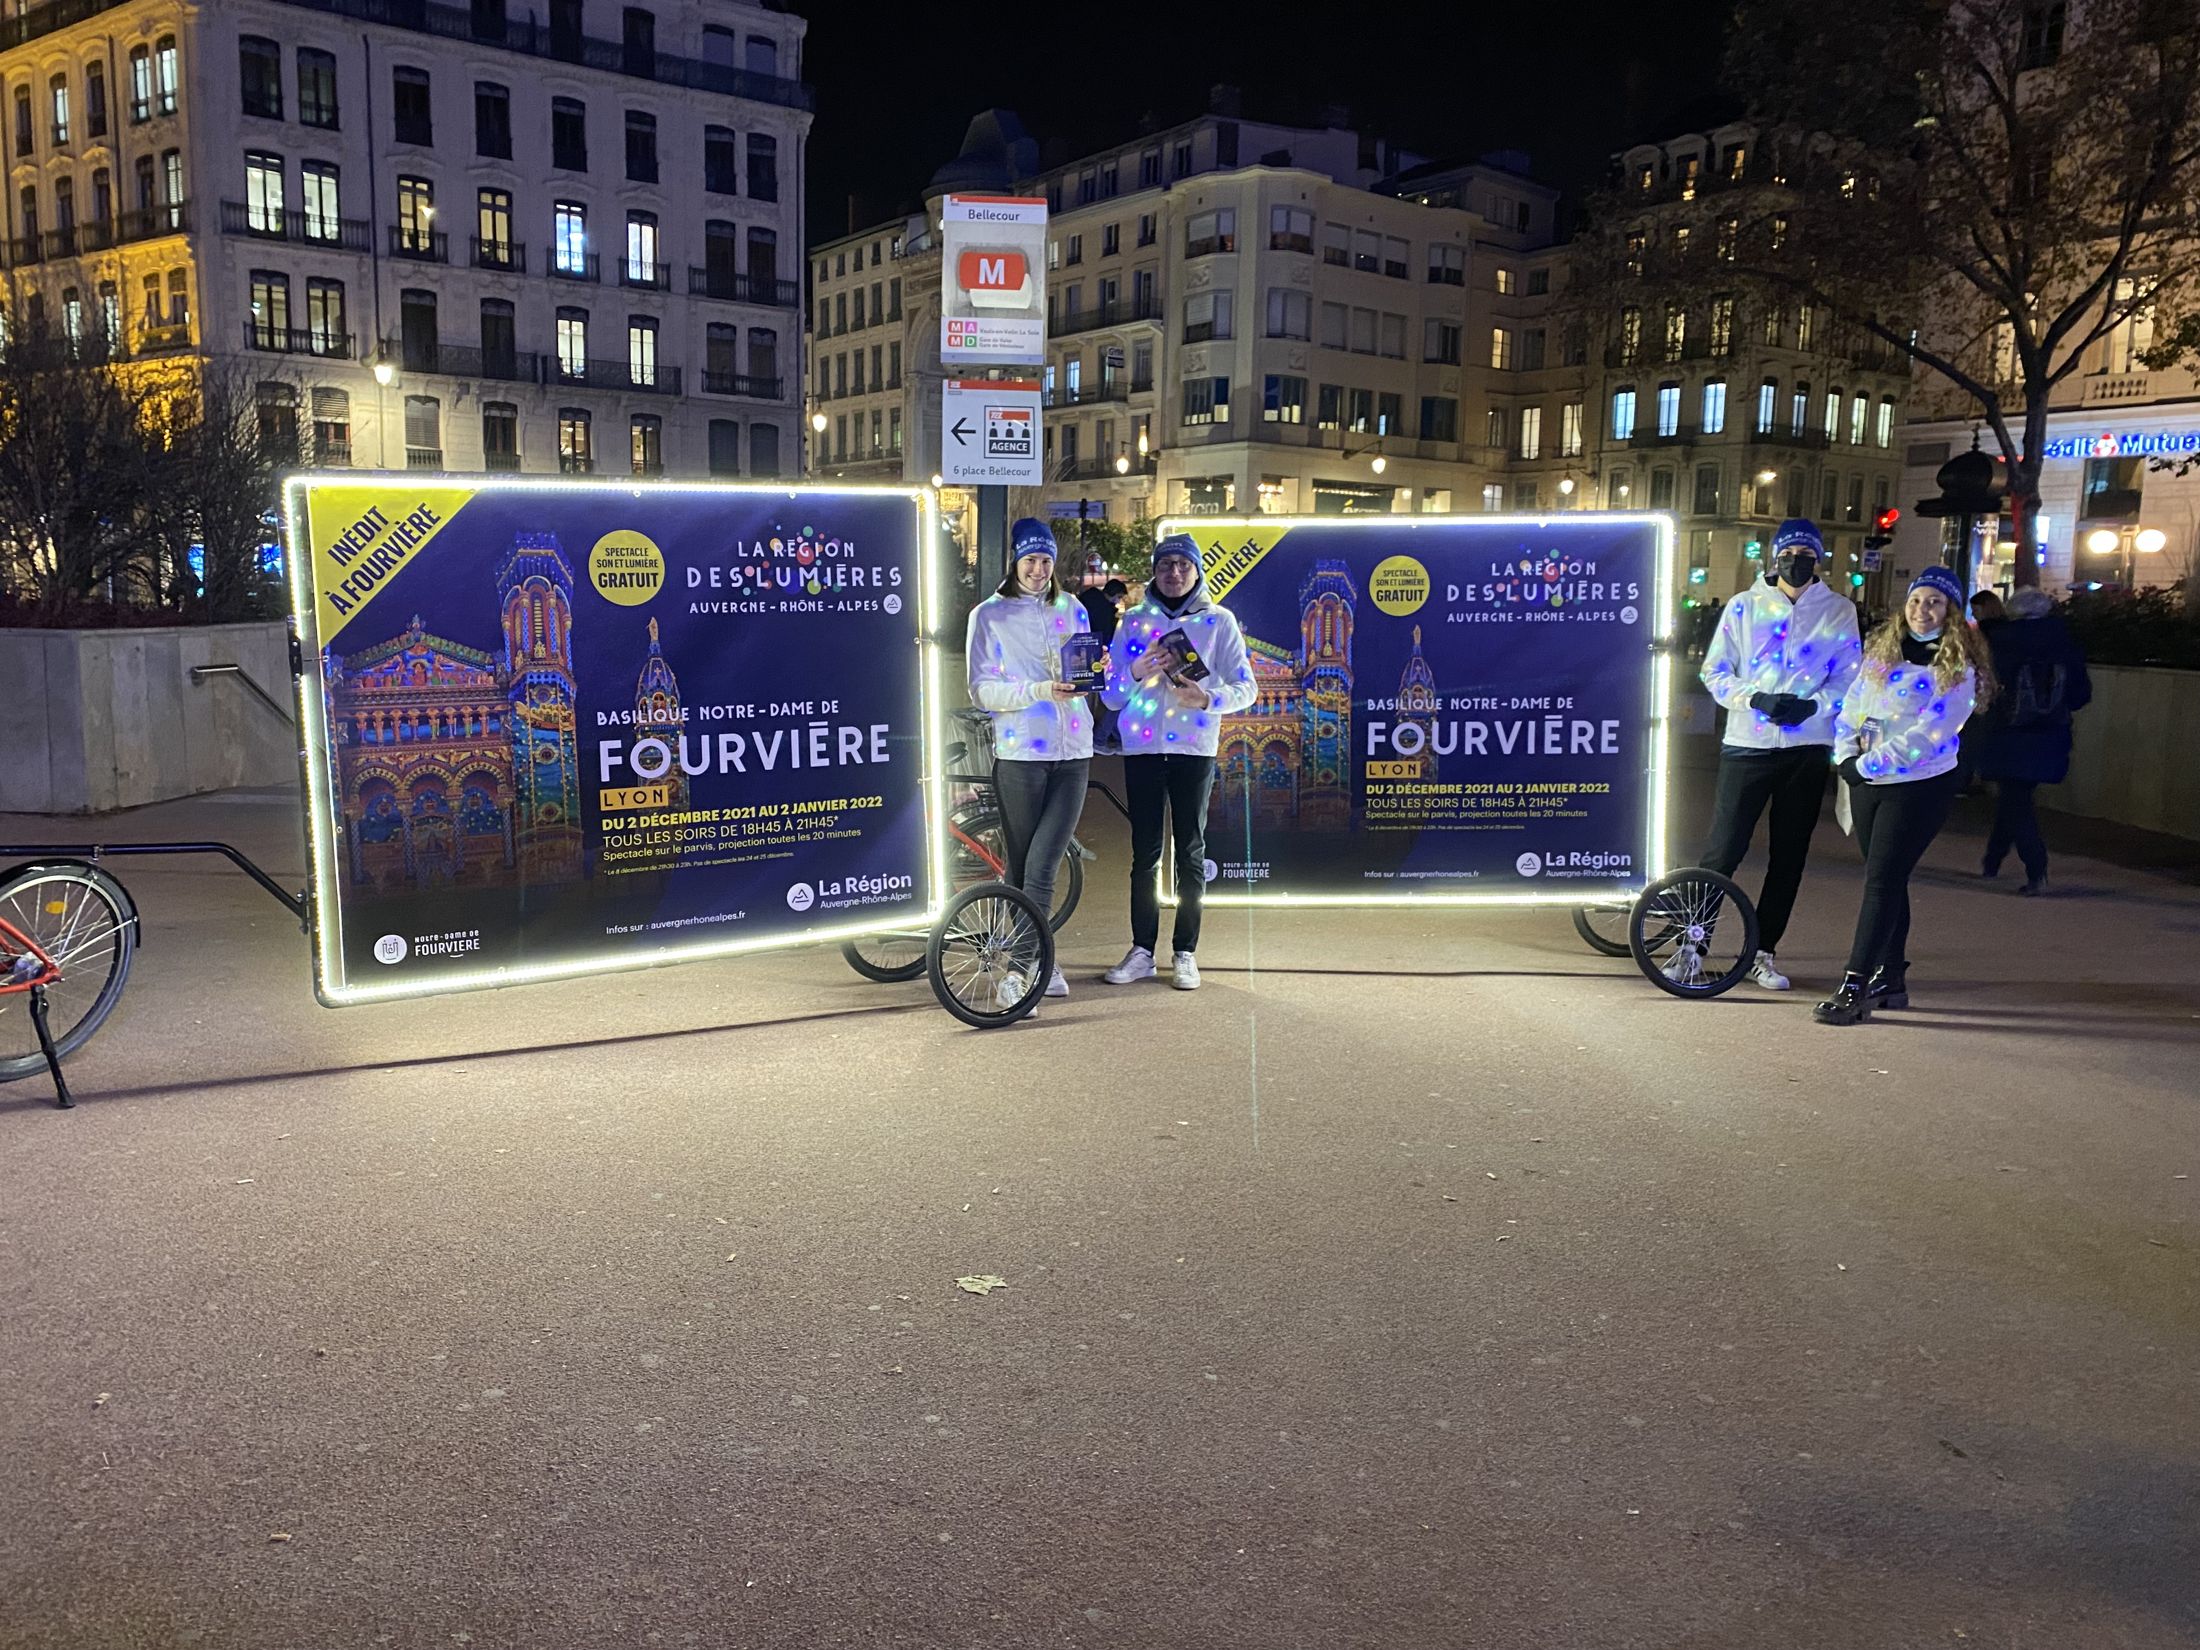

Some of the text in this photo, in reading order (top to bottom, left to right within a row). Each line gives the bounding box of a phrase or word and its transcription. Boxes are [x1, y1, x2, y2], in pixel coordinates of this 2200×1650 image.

[968, 208, 1021, 221] Bellecour
[978, 258, 1005, 285] M
[991, 442, 1028, 452] AGENCE
[2121, 433, 2200, 457] Mutue
[953, 465, 1032, 477] 6 place Bellecour
[327, 505, 389, 567] INÉDIT
[605, 547, 649, 556] SPECTACLE
[737, 541, 764, 558] LA
[324, 502, 441, 616] À FOURVIÈRE
[596, 557, 659, 568] SON ET LUMIÈRE
[686, 566, 743, 588] DES
[1383, 569, 1417, 577] SPECTACLE
[1491, 562, 1515, 576] LA
[598, 572, 659, 588] GRATUIT
[1376, 589, 1425, 602] GRATUIT
[1447, 584, 1495, 602] DES
[1367, 698, 1442, 711] BASILIQUE
[1557, 697, 1573, 709] DE
[597, 707, 690, 726] BASILIQUE
[821, 700, 839, 714] DE
[1369, 764, 1418, 776] LYON
[1366, 782, 1610, 794] DU 2 DÉCEMBRE 2021 AU 2 JANVIER 2022
[604, 788, 664, 807] LYON
[1366, 798, 1397, 808] TOUS
[1400, 798, 1421, 808] LES
[1424, 798, 1459, 808] SOIRS
[1462, 798, 1477, 808] DE
[1480, 797, 1515, 808] 18H45
[1517, 795, 1526, 807] À
[602, 796, 883, 831] DU 2 DÉCEMBRE 2021 AU 2 JANVIER 2022
[1365, 810, 1406, 819] Spectacle
[1422, 810, 1429, 818] le
[1459, 810, 1501, 819] projection
[1543, 809, 1554, 817] 20
[602, 833, 642, 848] TOUS
[646, 831, 671, 844] LES
[674, 826, 717, 841] SOIRS
[720, 824, 738, 838] DE
[741, 820, 781, 835] 18H45
[784, 817, 793, 831] À
[603, 828, 861, 861] Spectacle sur le parvis, projection toutes les 20 minutes
[1546, 851, 1631, 869] La Région
[1364, 870, 1382, 878] Infos
[1546, 869, 1631, 878] Auvergne-Rhône-Alpes
[819, 873, 912, 897] La Région
[820, 891, 912, 909] Auvergne-Rhône-Alpes
[606, 924, 628, 935] Infos
[630, 923, 644, 932] sur
[650, 910, 746, 930] auvergnerhonealpes.fr
